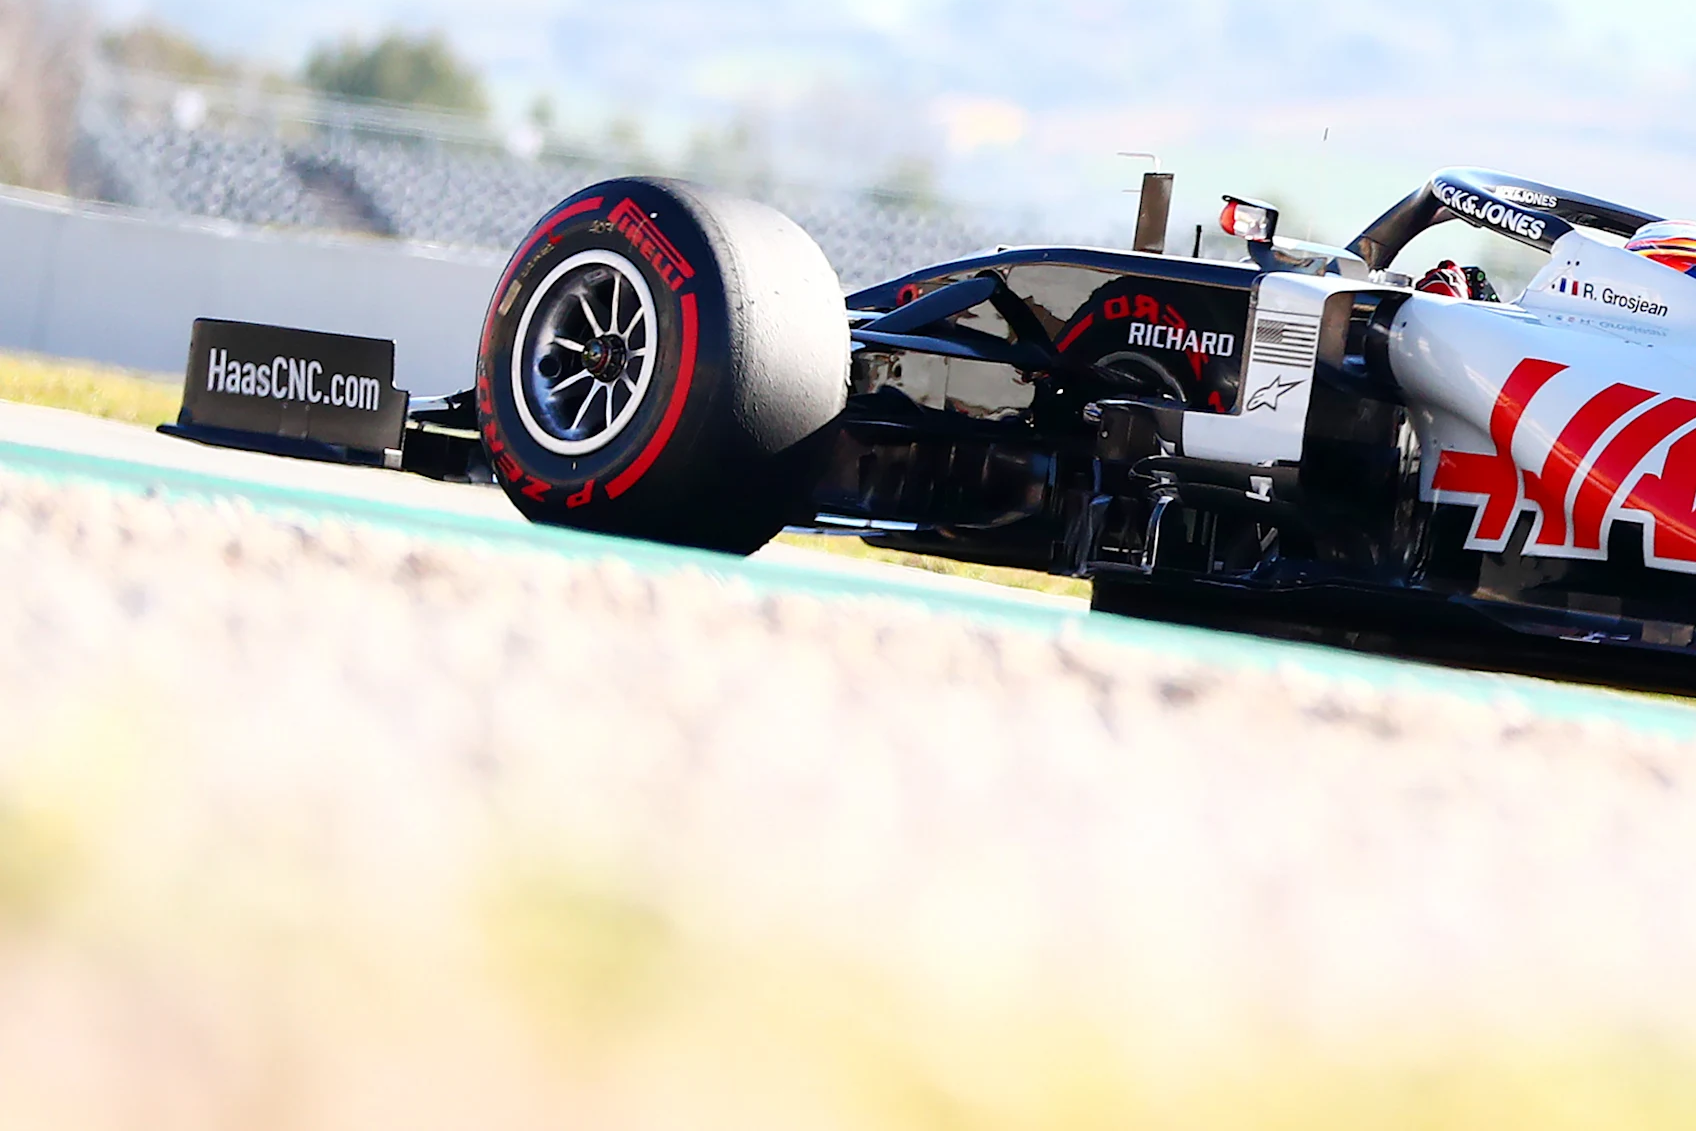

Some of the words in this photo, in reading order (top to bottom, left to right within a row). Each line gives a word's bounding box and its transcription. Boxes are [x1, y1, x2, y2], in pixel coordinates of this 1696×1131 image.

[607, 197, 696, 291] PIRELLI
[1583, 283, 1597, 300] R.
[1602, 288, 1668, 317] Grosjean
[1128, 322, 1235, 357] RICHARD
[207, 348, 379, 411] HaasCNC.com
[479, 376, 552, 502] ZERO
[566, 479, 596, 509] P
